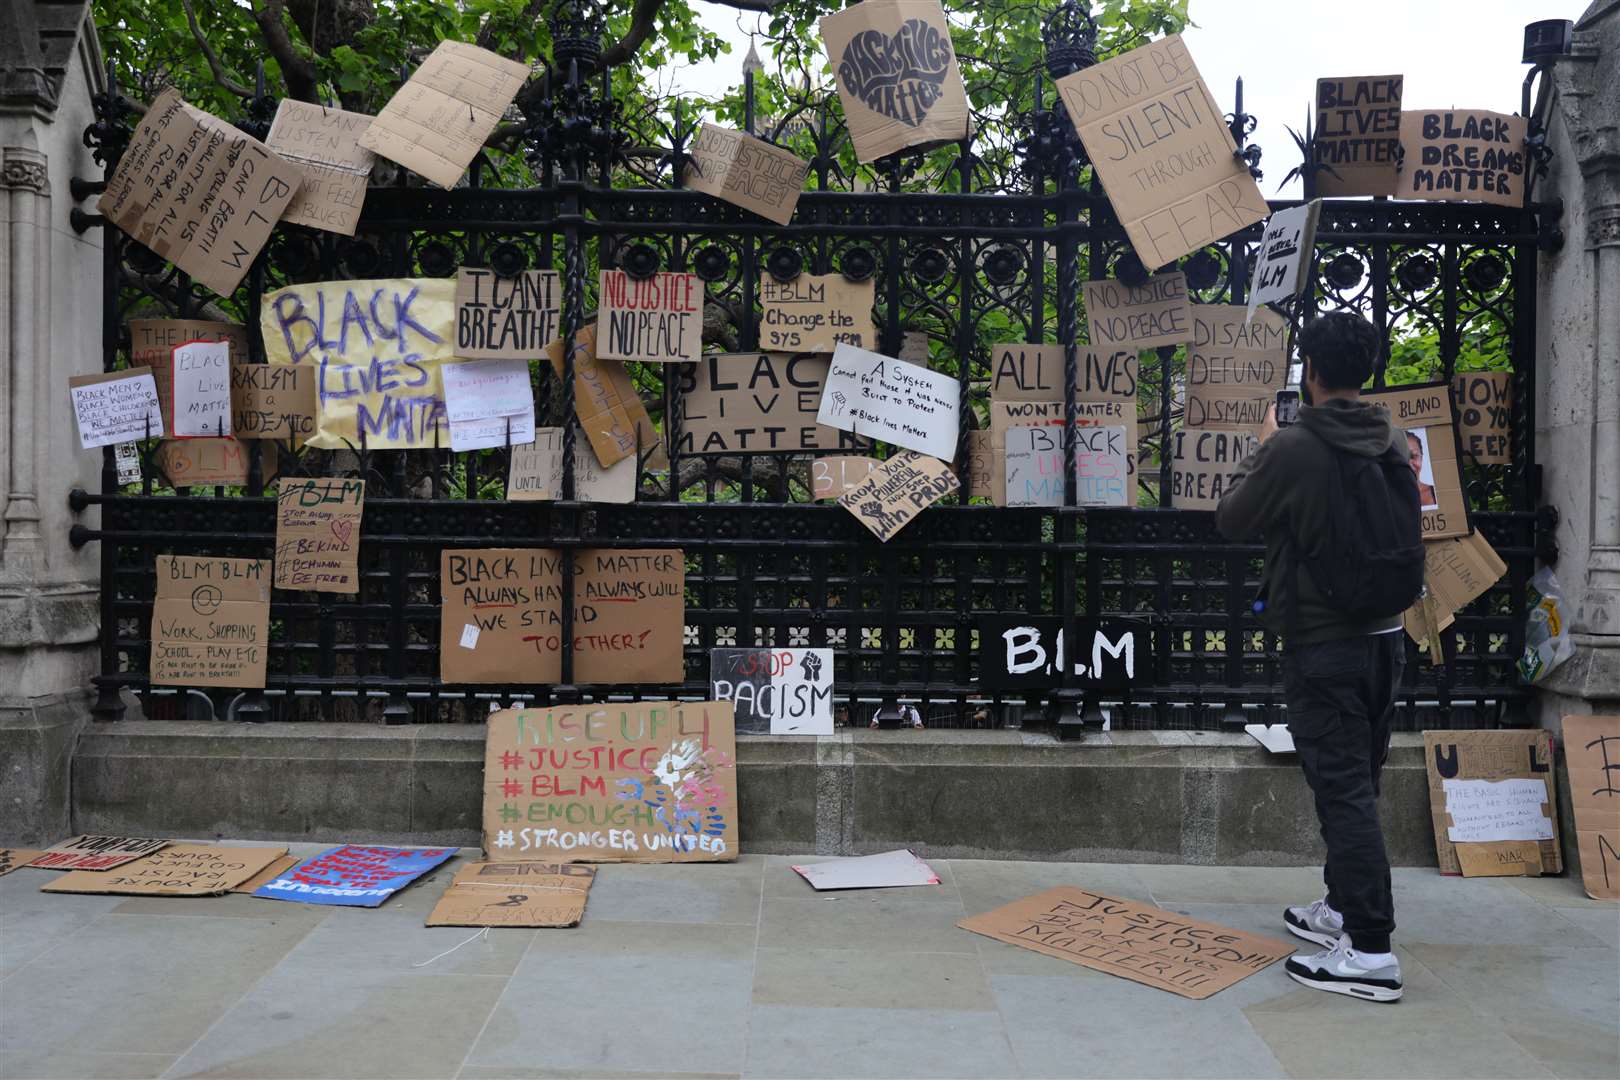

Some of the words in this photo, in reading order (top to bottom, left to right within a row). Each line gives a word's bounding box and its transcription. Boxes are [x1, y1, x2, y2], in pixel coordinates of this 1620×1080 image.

[1065, 79, 1103, 118] DO
[1101, 56, 1149, 103] NOT
[1151, 39, 1193, 84] BE
[1319, 80, 1402, 108] BLACK
[158, 100, 184, 130] MAKE
[283, 102, 312, 122] YOU
[1102, 87, 1202, 161] SILENT
[1319, 107, 1401, 137] LIVES
[1423, 113, 1510, 143] BLACK
[176, 119, 210, 170] JUSTICE
[192, 128, 227, 181] EQUALITY
[226, 137, 249, 168] STOP
[143, 144, 175, 186] RACE
[696, 128, 720, 153] NO
[719, 135, 806, 190] JUSTICE
[1130, 142, 1217, 191] THROUGH
[1422, 144, 1523, 175] DREAMS
[160, 169, 178, 188] FOR
[201, 168, 228, 215] KILLING
[1413, 169, 1511, 195] MATTER
[144, 186, 166, 212] ALL
[179, 181, 194, 205] FOR
[155, 207, 177, 237] ALL
[181, 219, 200, 242] US
[1141, 181, 1266, 263] FEAR
[465, 271, 490, 307] I
[604, 272, 627, 309] NO
[626, 273, 697, 312] JUSTICE
[764, 281, 825, 301] #BLM
[1090, 283, 1119, 311] NO
[1122, 276, 1184, 306] JUSTICE
[273, 287, 444, 364] BLACK
[458, 308, 559, 350] BREATHE
[766, 308, 825, 331] Change
[829, 310, 854, 326] the
[1094, 316, 1126, 344] NO
[1128, 307, 1189, 339] PEACE
[140, 328, 177, 346] THE
[610, 310, 635, 356] NO
[637, 312, 691, 359] PEACE
[1194, 323, 1284, 350] DISARM
[180, 352, 225, 371] BLAC
[680, 354, 820, 393] BLAC
[870, 360, 885, 378] A
[995, 351, 1050, 391] ALL
[1190, 354, 1274, 385] DEFUND
[109, 383, 132, 396] MEN
[231, 366, 298, 391] RACISM
[320, 353, 428, 407] LIVES
[1453, 377, 1510, 405] HOW
[357, 394, 449, 445] MATTE
[683, 391, 820, 420] LIVE
[907, 398, 935, 414] Protect
[1006, 403, 1062, 417] WON'T
[1074, 403, 1122, 417] MATTER
[1399, 396, 1440, 418] BLAND
[1031, 429, 1121, 455] BLACK
[1174, 432, 1186, 459] I
[278, 480, 363, 508] #BLM
[515, 476, 542, 490] UNTIL
[909, 469, 958, 509] PRIDE
[1420, 514, 1447, 532] 015
[450, 555, 519, 585] BLACK
[597, 555, 678, 575] MATTER
[192, 584, 223, 616] @
[463, 587, 530, 606] ALWAYS
[586, 581, 646, 600] ALWAYS
[649, 582, 681, 597] WILL
[207, 621, 257, 642] SHOPPING
[473, 613, 507, 631] WE
[207, 646, 232, 661] PLAY
[236, 646, 259, 664] ETC
[522, 630, 652, 653] TOETHER?
[738, 651, 794, 677] STOP
[713, 680, 834, 719] RACISM
[620, 709, 669, 741] UP
[679, 708, 710, 751] 4
[499, 774, 607, 798] #BLM
[496, 802, 656, 828] #ENOUGH
[494, 828, 639, 852] #STRONGER
[641, 831, 727, 856] UNITED
[133, 869, 225, 879] RACIST
[479, 863, 594, 877] END
[1050, 903, 1106, 924] FOR
[1062, 891, 1242, 945] JUSTICE
[1039, 912, 1144, 948] BLACK
[1152, 947, 1223, 973] LIVES
